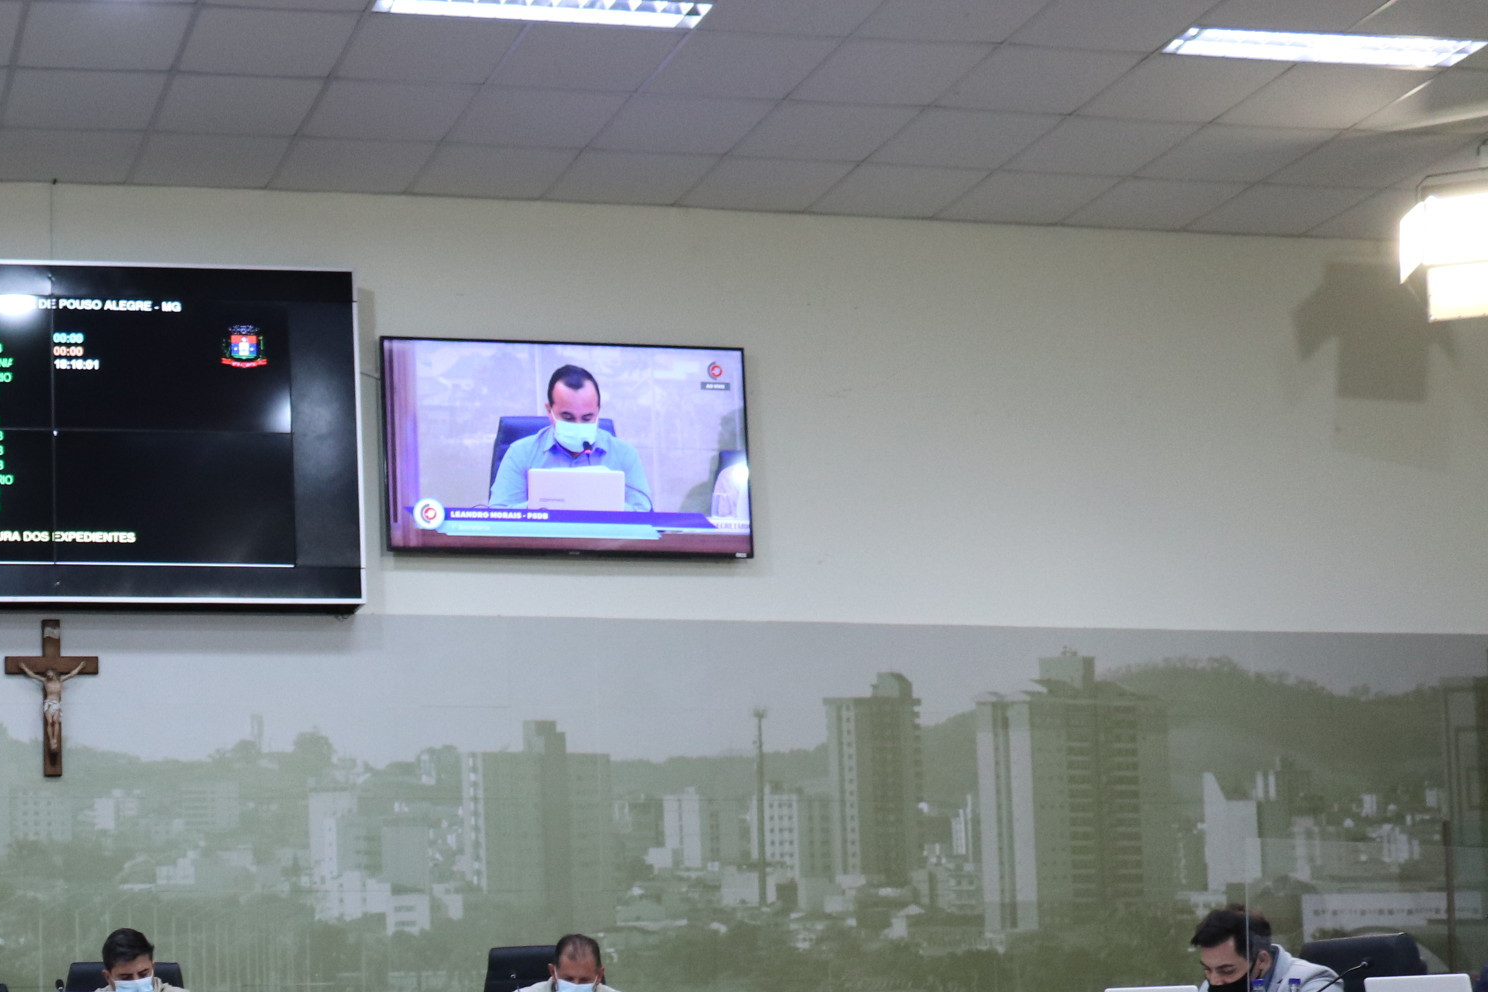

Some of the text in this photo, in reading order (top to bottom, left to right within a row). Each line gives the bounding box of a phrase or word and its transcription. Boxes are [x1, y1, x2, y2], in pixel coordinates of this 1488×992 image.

[39, 298, 56, 309] DE
[59, 299, 102, 310] POUSO
[103, 300, 152, 311] ALEGRE
[161, 301, 182, 312] MG
[53, 332, 84, 343] 00:00
[53, 345, 84, 356] 00:00
[450, 511, 489, 519] LEANDRO
[490, 511, 522, 520] MORAIS
[527, 512, 549, 520] PSDB
[23, 531, 50, 542] DOS
[52, 531, 136, 543] EXPEDIENTES
